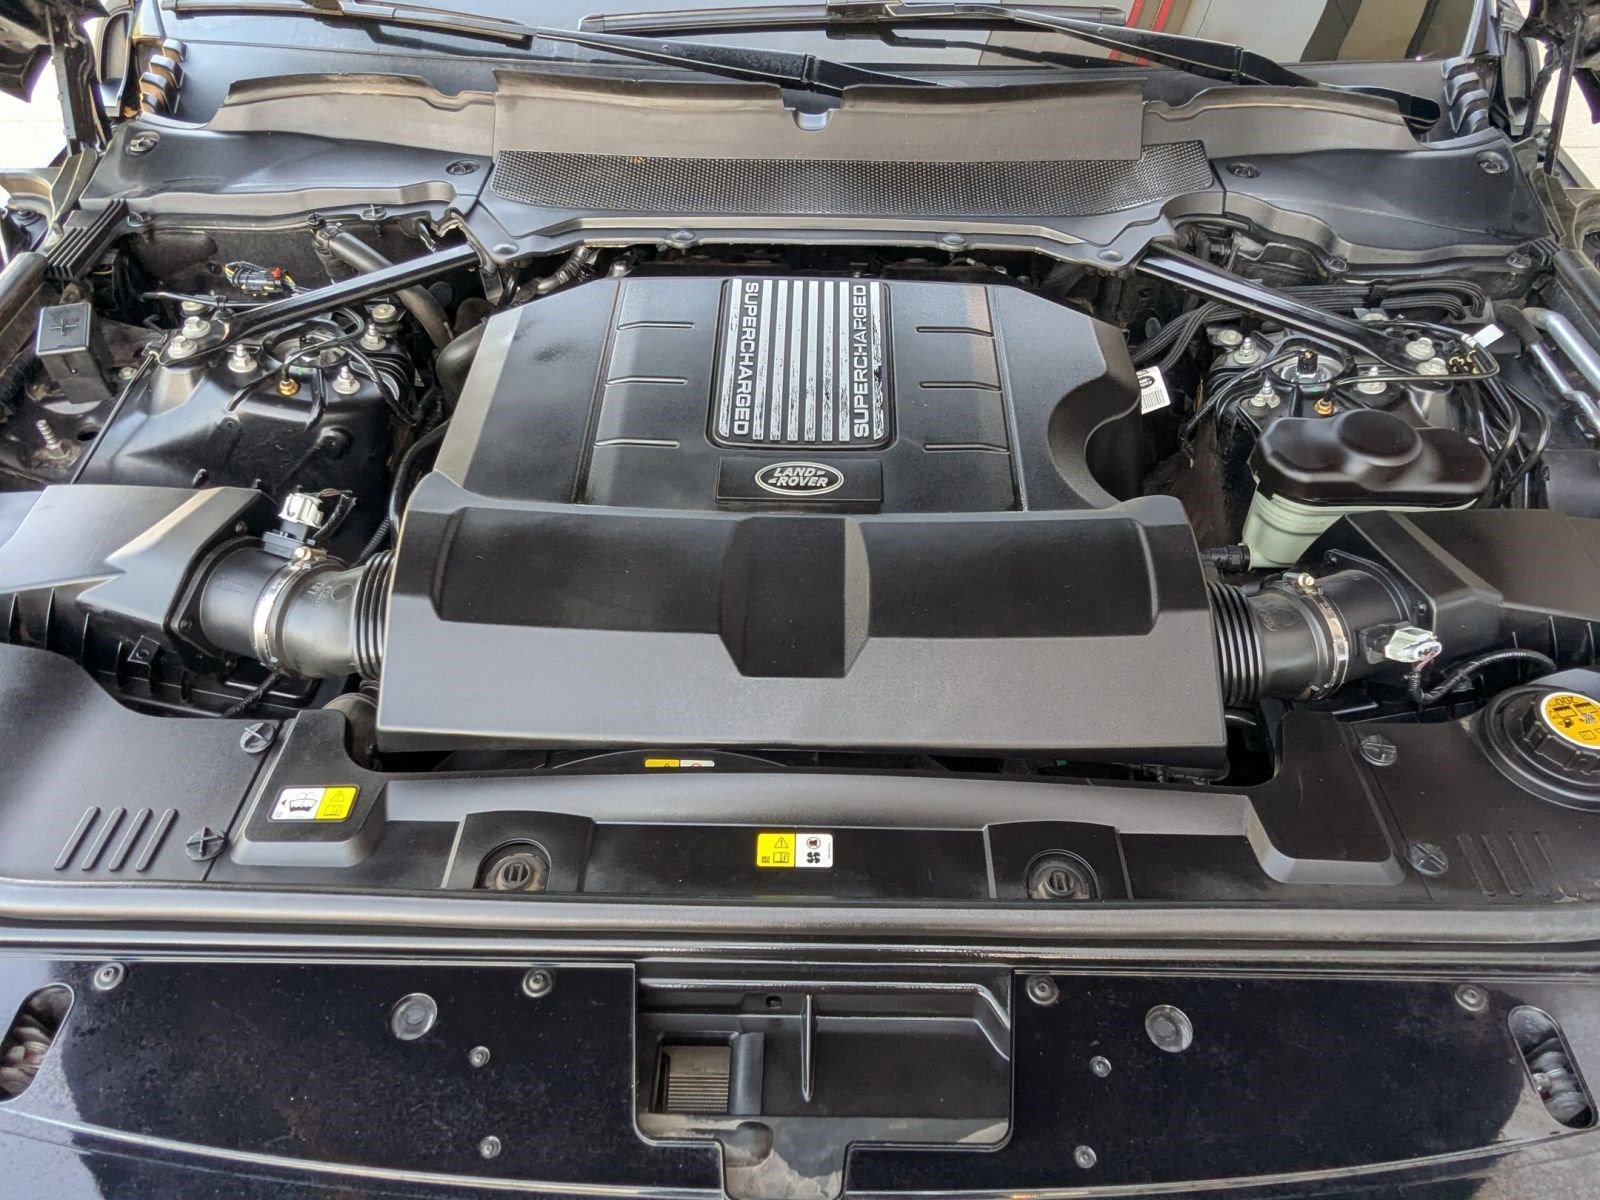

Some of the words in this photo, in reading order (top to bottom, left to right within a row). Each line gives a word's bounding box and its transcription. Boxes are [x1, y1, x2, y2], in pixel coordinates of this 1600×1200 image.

[733, 281, 759, 436] SUPERCHARGED
[853, 284, 870, 438] SUPERCHARGED
[773, 467, 816, 477] LAND
[776, 476, 829, 487] ROVER
